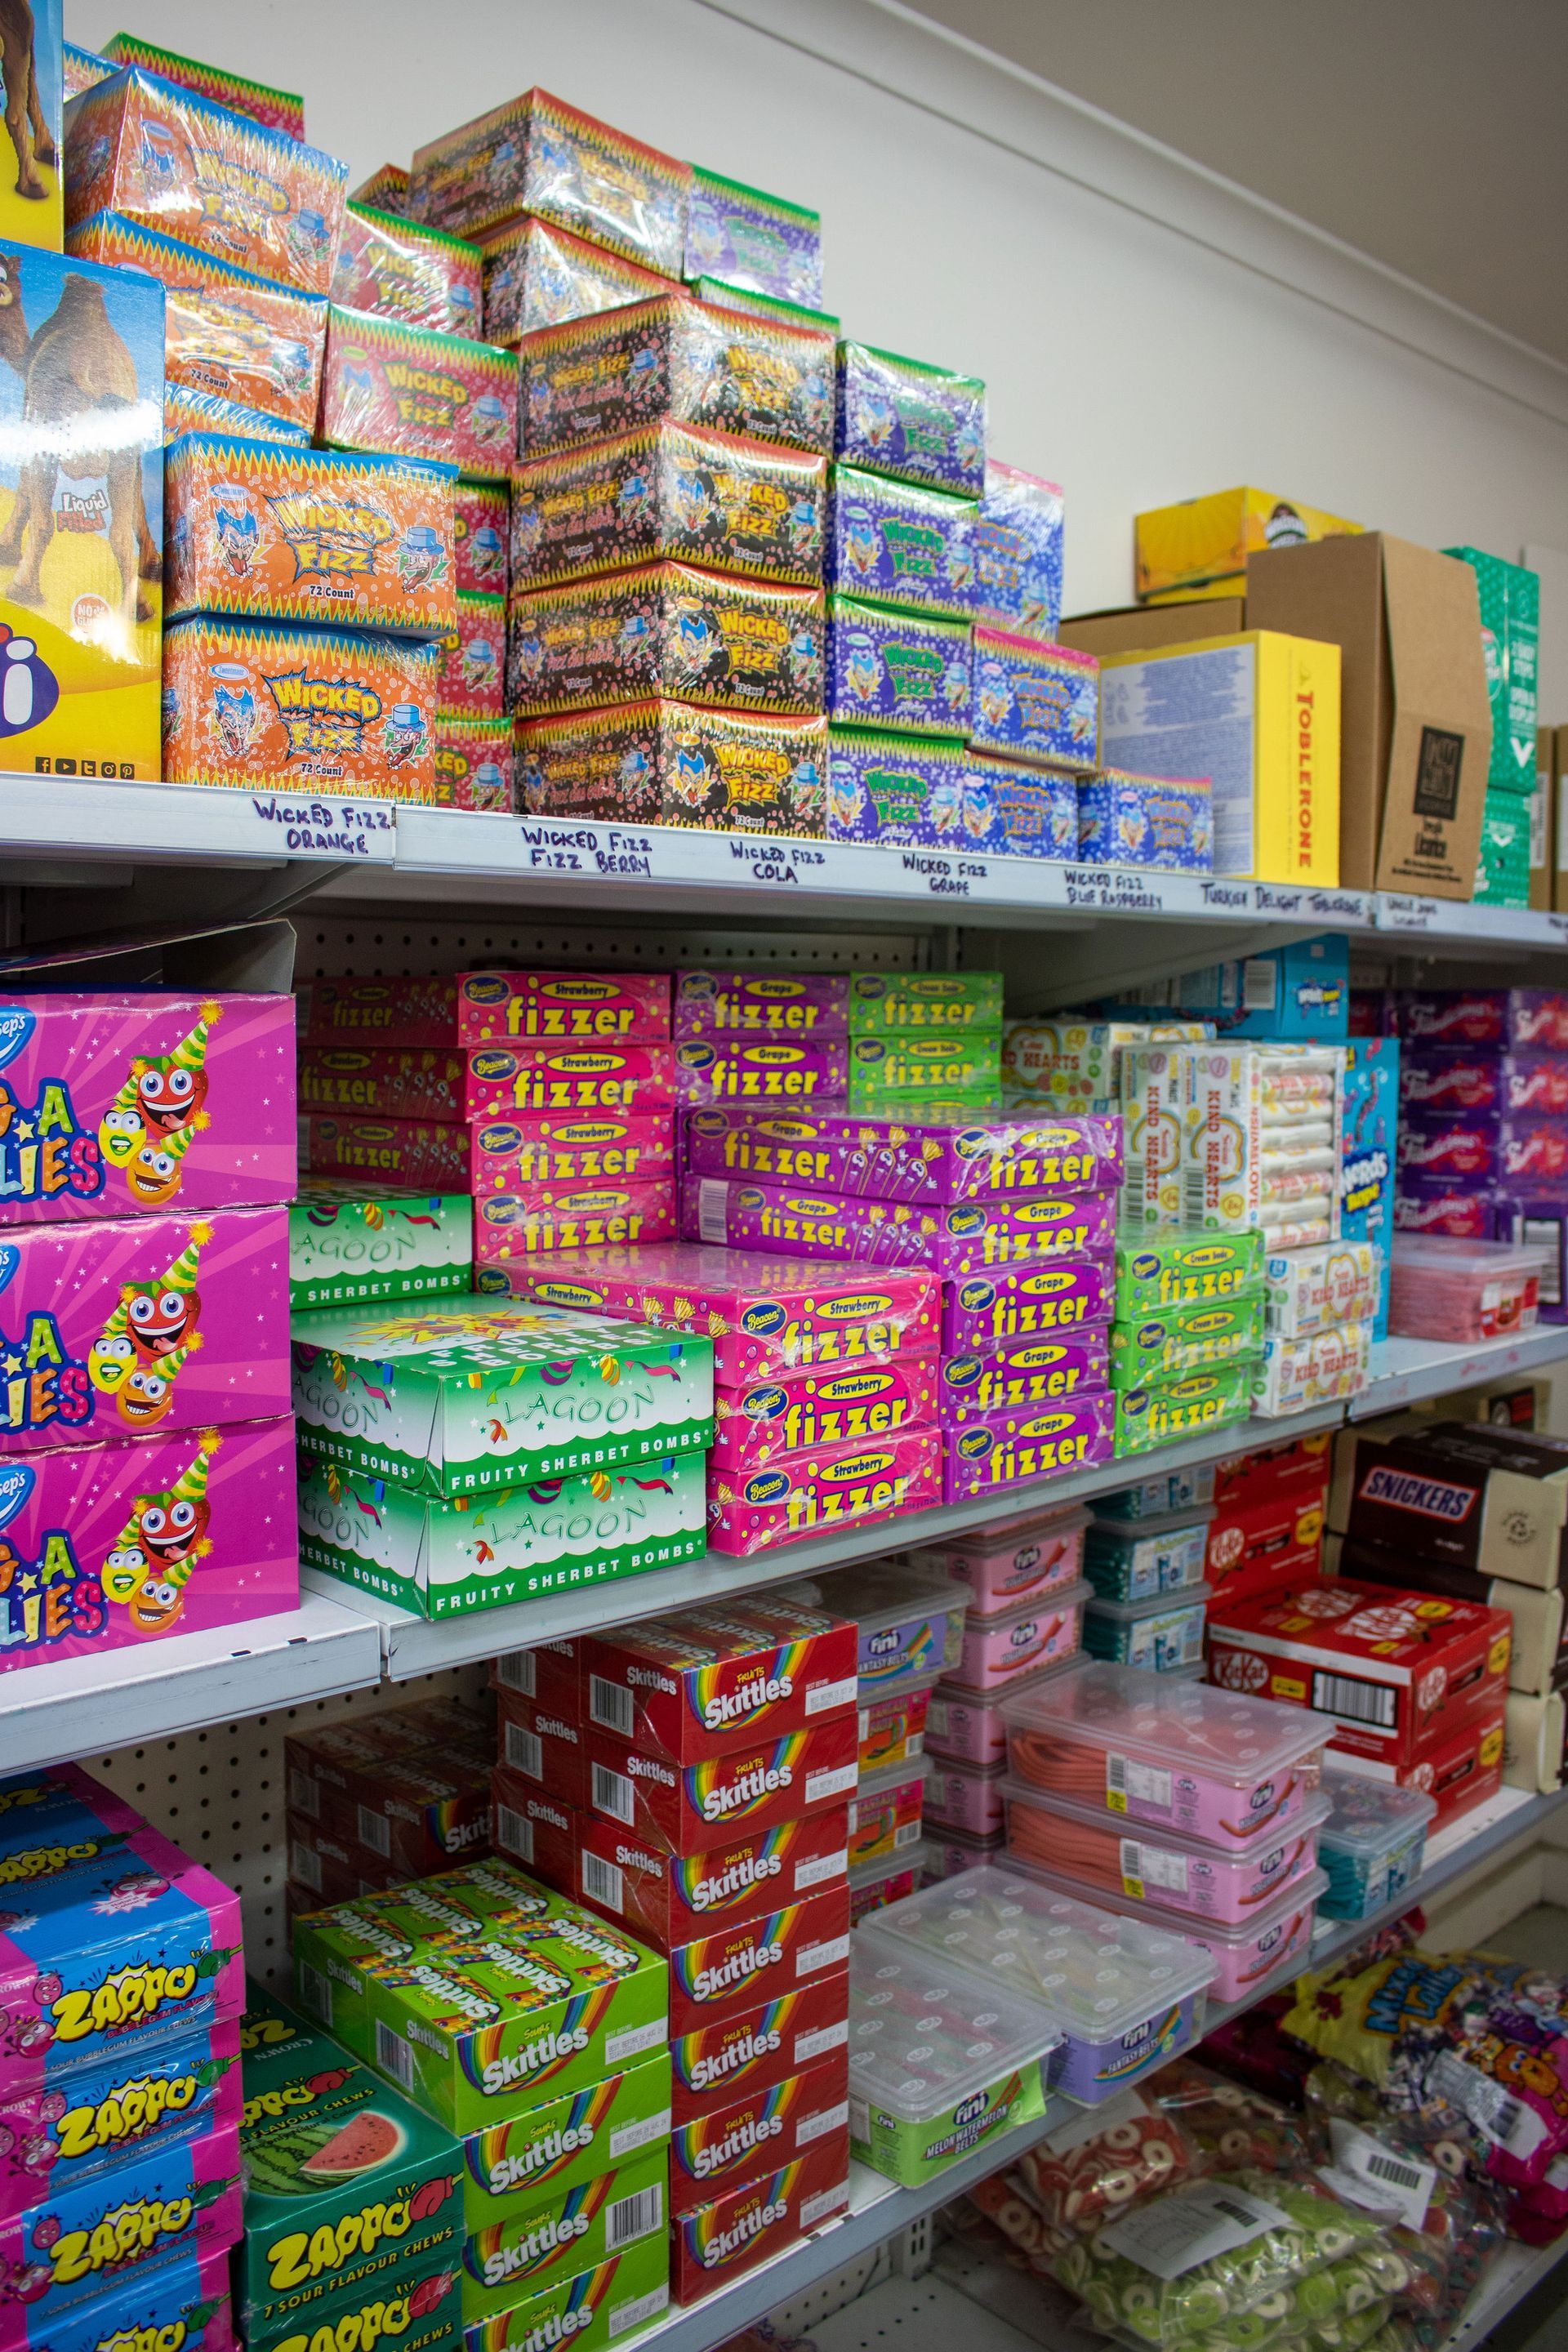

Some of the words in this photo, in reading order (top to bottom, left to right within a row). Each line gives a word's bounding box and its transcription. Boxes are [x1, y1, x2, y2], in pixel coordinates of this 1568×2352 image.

[190, 368, 206, 382] 72
[207, 372, 229, 390] Count
[385, 363, 466, 404] WICKED
[61, 490, 108, 514] Liquid
[275, 501, 391, 543] WICKED
[297, 541, 372, 574] FIZZ
[310, 586, 323, 596] 72
[326, 587, 354, 599] Count
[732, 644, 778, 670] FIZZ
[272, 680, 380, 719] WICKED
[736, 684, 747, 694] 72
[749, 684, 764, 697] Count
[292, 722, 363, 752] FIZZ
[301, 763, 314, 773] 72
[315, 764, 342, 776] Count
[719, 743, 790, 776] WICKED
[728, 776, 777, 804] FIZZ
[866, 771, 929, 799] WICKED
[1297, 691, 1314, 867] TOBLERONE
[252, 798, 333, 827] WICKED
[341, 807, 390, 829] FIZZ
[876, 799, 920, 825] FIZZ
[287, 828, 368, 853] ORANGE
[522, 826, 598, 851] WICKED
[609, 832, 653, 852] FIZZ
[730, 841, 786, 864] WICKED
[792, 849, 825, 866] FIZZ
[531, 849, 582, 869] FIZZ
[596, 851, 652, 877] BERRY
[753, 863, 798, 883] COLA
[902, 853, 950, 876] WICKED
[958, 862, 988, 877] FIZZ
[930, 878, 970, 895] GRAPE
[1065, 871, 1110, 888] WICKED
[1116, 876, 1143, 890] FIZZ
[1067, 888, 1096, 904] BLUE
[1101, 891, 1162, 910] RASPBERRY
[1255, 886, 1303, 912] DELIGHT
[555, 984, 608, 998] Strawberry
[760, 982, 792, 996] Grape
[506, 995, 635, 1036] fizzer
[715, 992, 818, 1029] fizzer
[562, 1057, 612, 1070] Strawberry
[759, 1048, 791, 1061] Grape
[513, 1069, 638, 1110] fizzer
[711, 1061, 817, 1096] fizzer
[1147, 1086, 1160, 1127] KIND
[1207, 1090, 1221, 1133] KIND
[566, 1128, 615, 1138] Strawberry
[518, 1141, 640, 1183] fizzer
[724, 1130, 831, 1178] fizzer
[990, 1148, 1095, 1191] fizzer
[1146, 1136, 1159, 1200] HEARTS
[1206, 1142, 1219, 1209] HEARTS
[797, 1200, 826, 1214] Grape
[1030, 1205, 1061, 1220] Grape
[523, 1210, 644, 1253] fizzer
[760, 1207, 846, 1247] fizzer
[983, 1223, 1088, 1265] fizzer
[308, 1282, 391, 1303] SHERBET
[402, 1275, 461, 1291] BOMBS
[545, 1287, 592, 1303] Strawberry
[1034, 1276, 1064, 1290] Grape
[747, 1309, 779, 1332] Beacon
[830, 1298, 881, 1316] Strawberry
[991, 1291, 1088, 1339] fizzer
[783, 1321, 906, 1368] fizzer
[1023, 1349, 1054, 1365] Grape
[831, 1379, 882, 1396] Strawberry
[978, 1365, 1080, 1412] fizzer
[504, 1385, 654, 1426] LAGOON
[784, 1396, 908, 1450] fizzer
[1033, 1416, 1062, 1432] Grape
[361, 1454, 409, 1479] BOMBS
[452, 1464, 528, 1490] FRUITY
[541, 1446, 629, 1472] SHERBET
[640, 1432, 702, 1454] BOMBS
[834, 1459, 884, 1477] Strawberry
[990, 1431, 1089, 1484] fizzer
[751, 1477, 784, 1500] Beacon
[786, 1475, 909, 1533] fizzer
[1365, 1470, 1474, 1519] SNICKERS
[490, 1499, 647, 1545] LAGOON
[298, 1545, 346, 1574] HERBET
[354, 1567, 399, 1596] BOMBS
[436, 1583, 515, 1611] FRUITY
[528, 1559, 618, 1591] SHERBET
[631, 1543, 695, 1567] BOMBS
[626, 1666, 677, 1695] Skittles
[737, 1667, 764, 1684] FRUITS
[858, 1657, 885, 1675] ANTASY
[704, 1675, 793, 1731] Skittles
[535, 1716, 577, 1744] Skittles
[627, 1756, 675, 1788] Skittles
[735, 1757, 764, 1775] FRUITS
[703, 1764, 792, 1821] Skittles
[527, 1801, 568, 1830] Skittles
[616, 1845, 662, 1878] Skittles
[724, 1847, 753, 1865] FRUITS
[692, 1854, 782, 1913] Skittles
[725, 1936, 754, 1956] FRUITS
[693, 1940, 782, 2003] Skittles
[51, 1964, 196, 2042] ZAPPO
[76, 2041, 127, 2062] BUBBLEGUM
[129, 2027, 166, 2045] FLAVOUR
[406, 2018, 449, 2061] Skittles
[723, 2025, 751, 2044] FRUITS
[483, 2026, 589, 2096] Skittles
[690, 2029, 781, 2091] Skittles
[1107, 2051, 1138, 2076] FANTASY
[1138, 2038, 1159, 2065] BELTS
[56, 2075, 197, 2158] ZAPPO
[251, 2109, 319, 2139] FLAVOUR
[324, 2088, 374, 2110] CHEWS
[725, 2111, 754, 2132] FRUITS
[693, 2114, 783, 2180] Skittles
[927, 2136, 955, 2159] MELON
[955, 2104, 1008, 2143] WATERMELON
[955, 2134, 978, 2154] BELTS
[489, 2126, 594, 2196] Skittles
[733, 2197, 760, 2219] FRUITS
[49, 2197, 192, 2283] ZAPPO
[267, 2195, 415, 2292] ZAPPO
[483, 2212, 590, 2287] Skittles
[703, 2197, 787, 2269] Skittles
[265, 2305, 272, 2319] 7
[278, 2287, 324, 2314] SOUR
[328, 2253, 398, 2293] FLAVOUR
[403, 2226, 453, 2258] CHEWS
